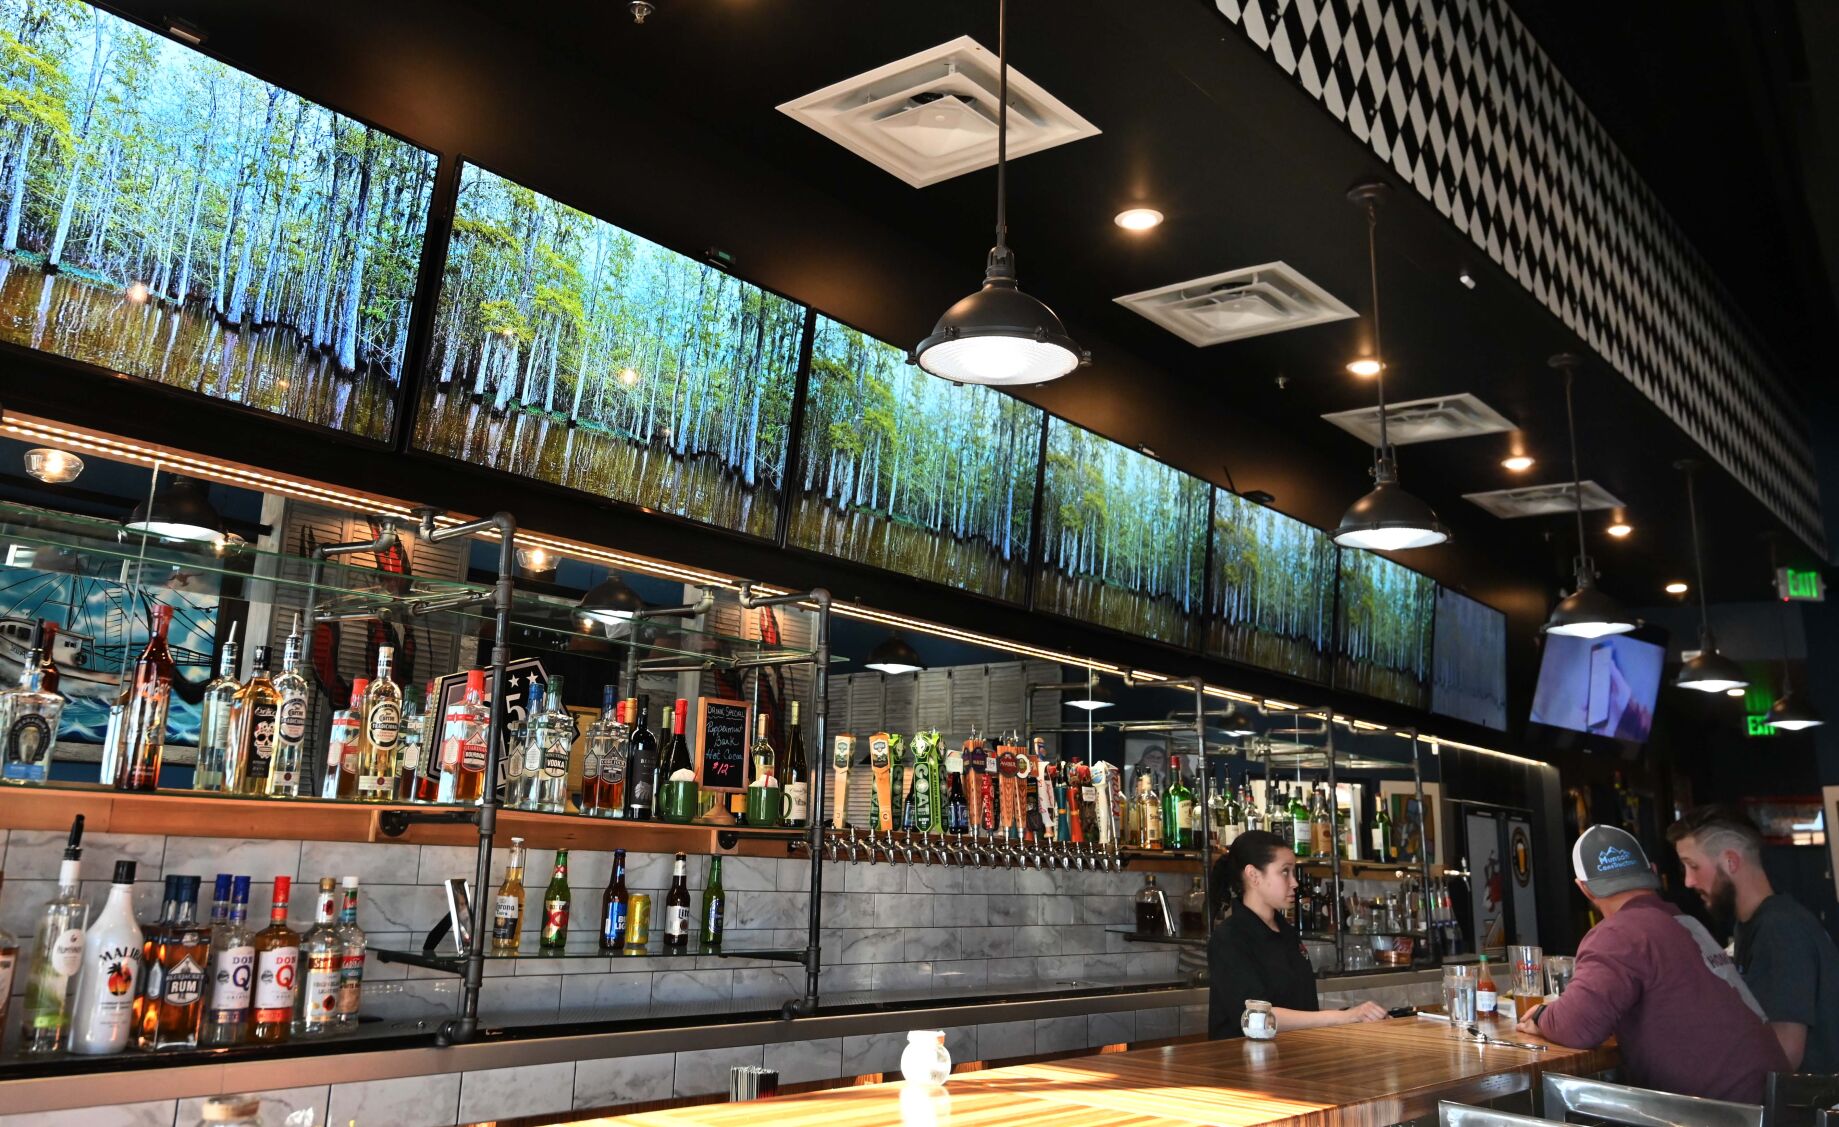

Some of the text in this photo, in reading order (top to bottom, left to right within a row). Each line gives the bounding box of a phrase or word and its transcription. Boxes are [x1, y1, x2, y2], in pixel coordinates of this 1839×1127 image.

[1786, 569, 1819, 598] EXIT
[547, 759, 565, 768] VODKA
[915, 763, 930, 816] GOAT
[170, 980, 197, 993] RUM
[232, 964, 251, 992] Q
[275, 964, 294, 991] Q
